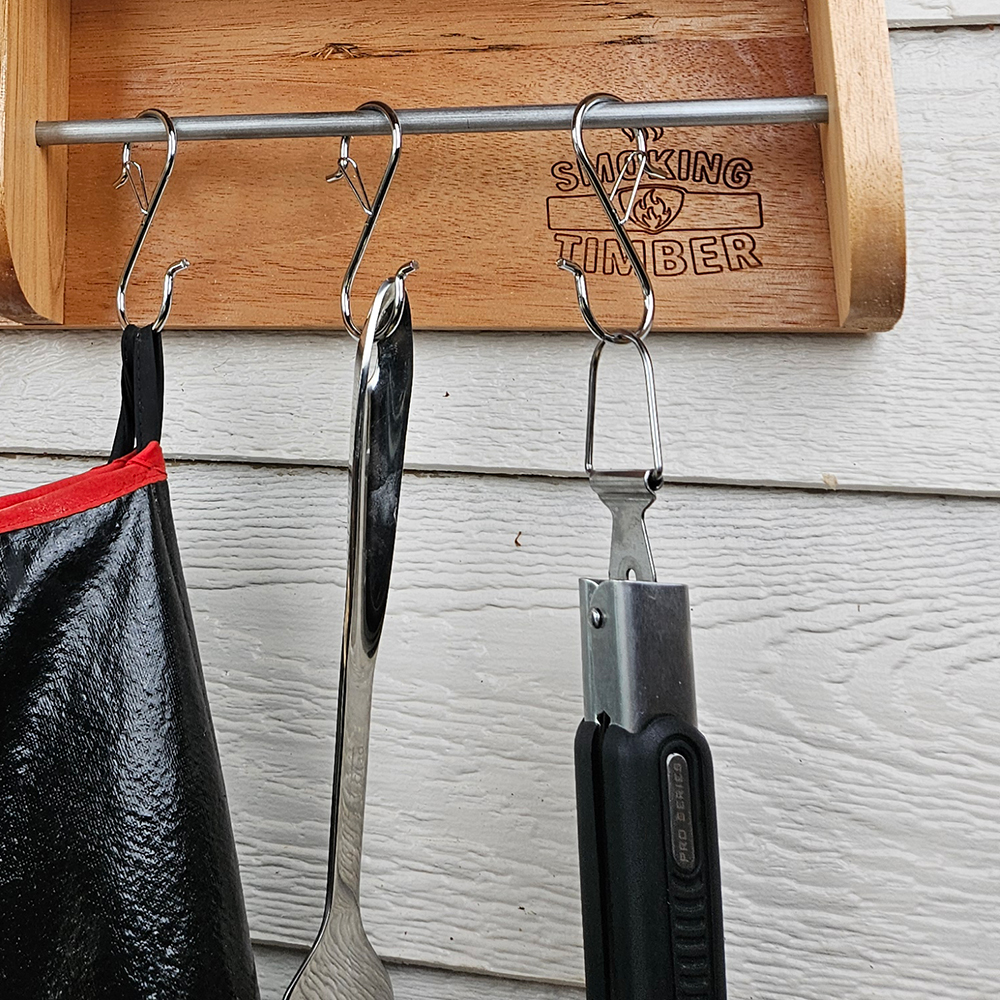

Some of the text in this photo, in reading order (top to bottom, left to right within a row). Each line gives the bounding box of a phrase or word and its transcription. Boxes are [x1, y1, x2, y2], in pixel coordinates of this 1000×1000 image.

[550, 149, 753, 191] SMOKING
[554, 232, 764, 276] TIMBER
[678, 829, 689, 863] PRO
